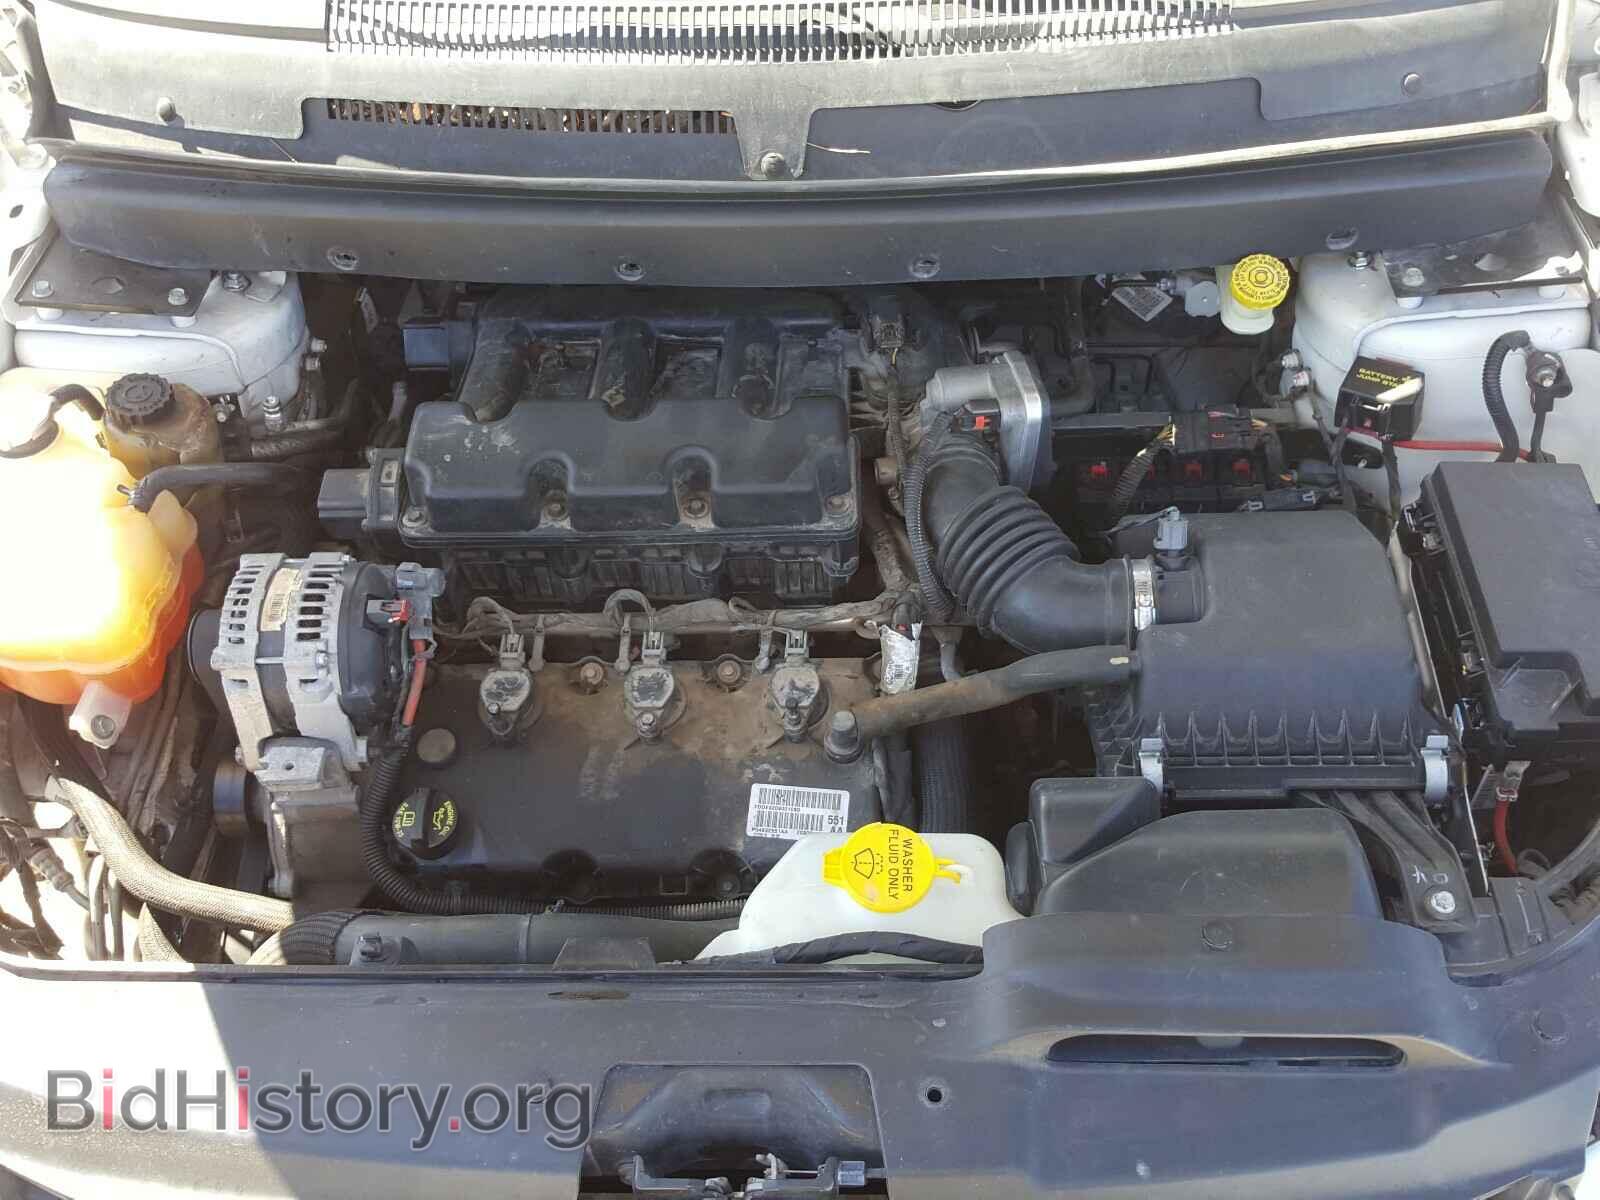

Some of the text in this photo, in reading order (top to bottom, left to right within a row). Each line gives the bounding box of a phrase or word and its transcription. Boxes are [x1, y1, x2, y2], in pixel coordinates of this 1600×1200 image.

[1359, 367, 1399, 382] BATTERY
[443, 801, 456, 826] ENGINE
[828, 815, 844, 825] 551
[888, 829, 899, 900] FLUID ONLY
[902, 838, 913, 892] WASHER
